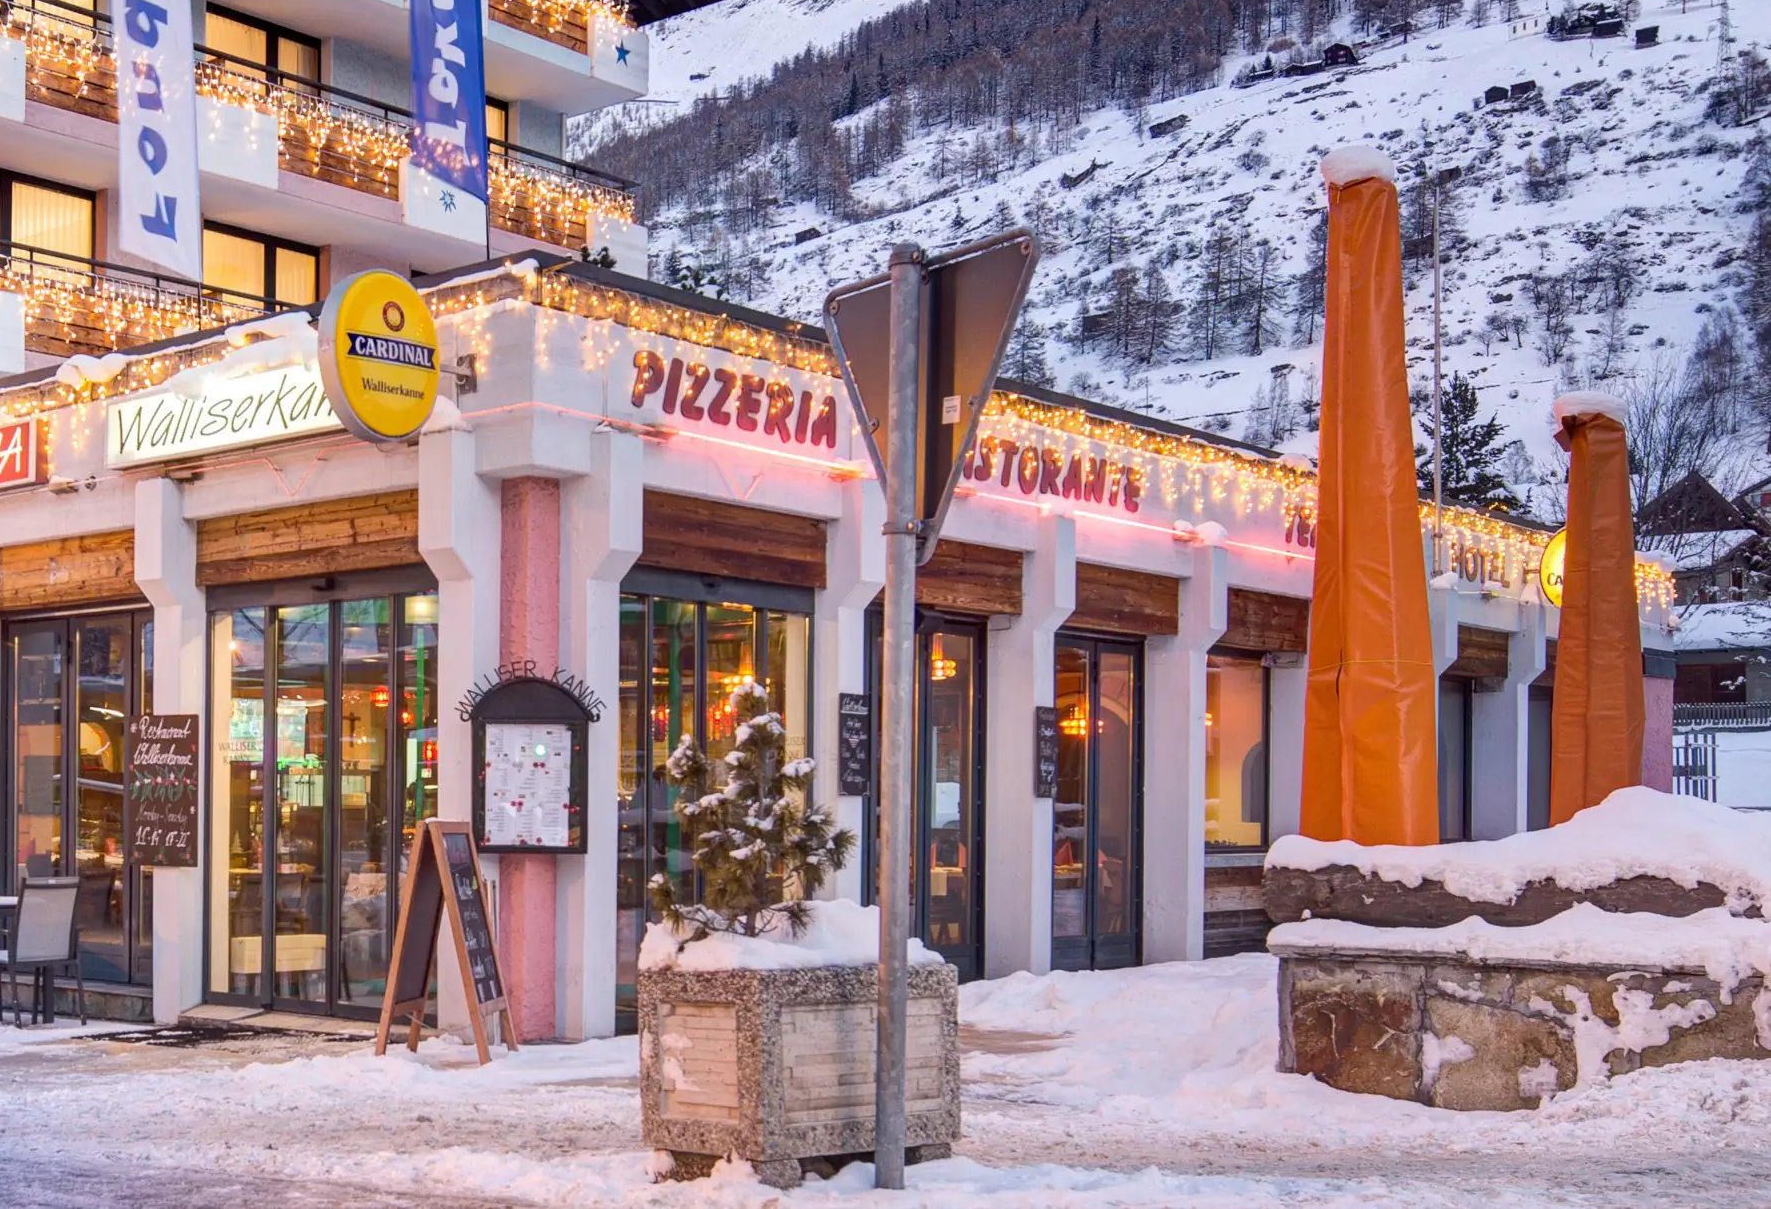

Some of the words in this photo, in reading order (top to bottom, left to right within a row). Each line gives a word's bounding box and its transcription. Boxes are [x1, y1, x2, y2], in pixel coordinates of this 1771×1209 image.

[354, 336, 432, 367] CARDINAL
[118, 374, 333, 455] Walliserkan
[361, 377, 425, 399] Walliserkanne
[631, 350, 837, 449] PIZZERIA
[963, 434, 1142, 514] ISTORANTE
[1451, 540, 1510, 589] HOTEL
[454, 660, 536, 716] WALLISER
[550, 666, 607, 715] KANNE
